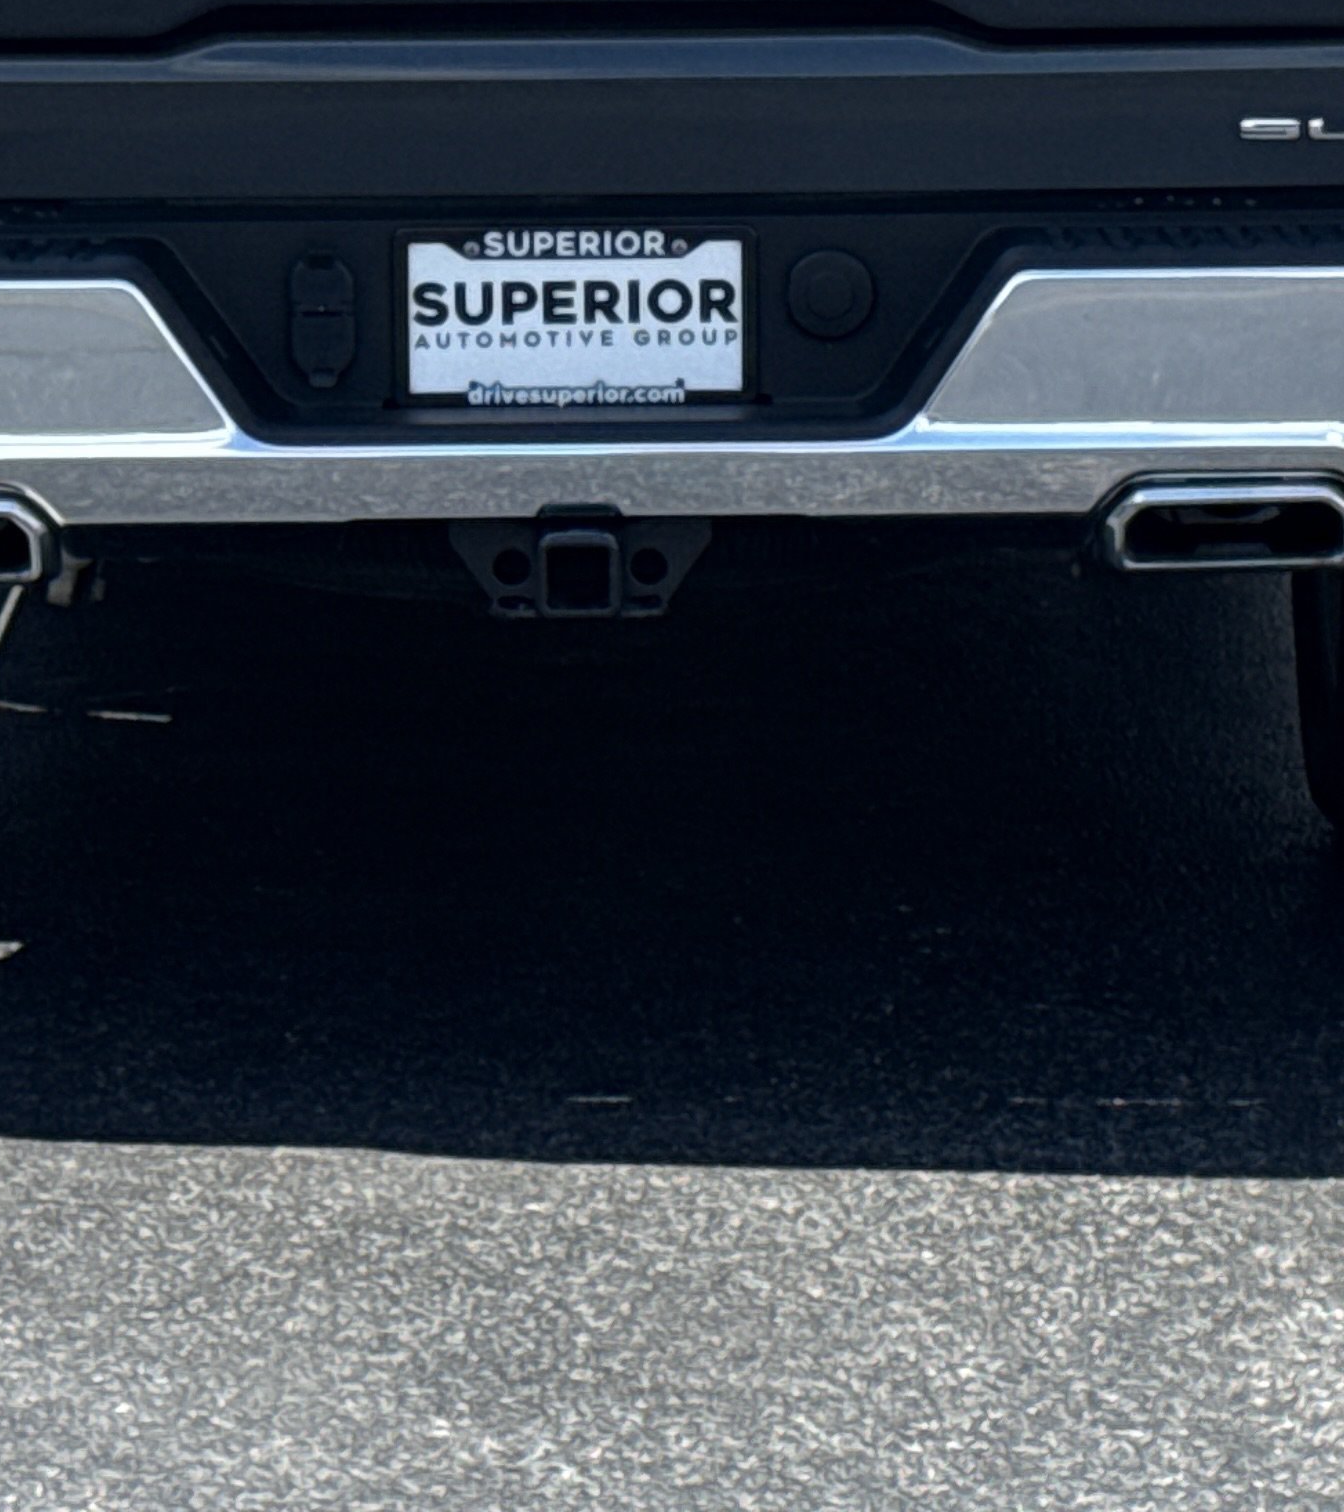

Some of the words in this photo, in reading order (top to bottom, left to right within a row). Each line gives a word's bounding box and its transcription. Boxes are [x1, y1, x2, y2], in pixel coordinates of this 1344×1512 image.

[483, 230, 666, 258] SUPERIOR
[413, 278, 739, 327] SUPERIOR
[414, 330, 614, 349] AUTOMOTIVE
[634, 329, 739, 347] GROUP
[467, 380, 686, 408] drivesuperior.com
